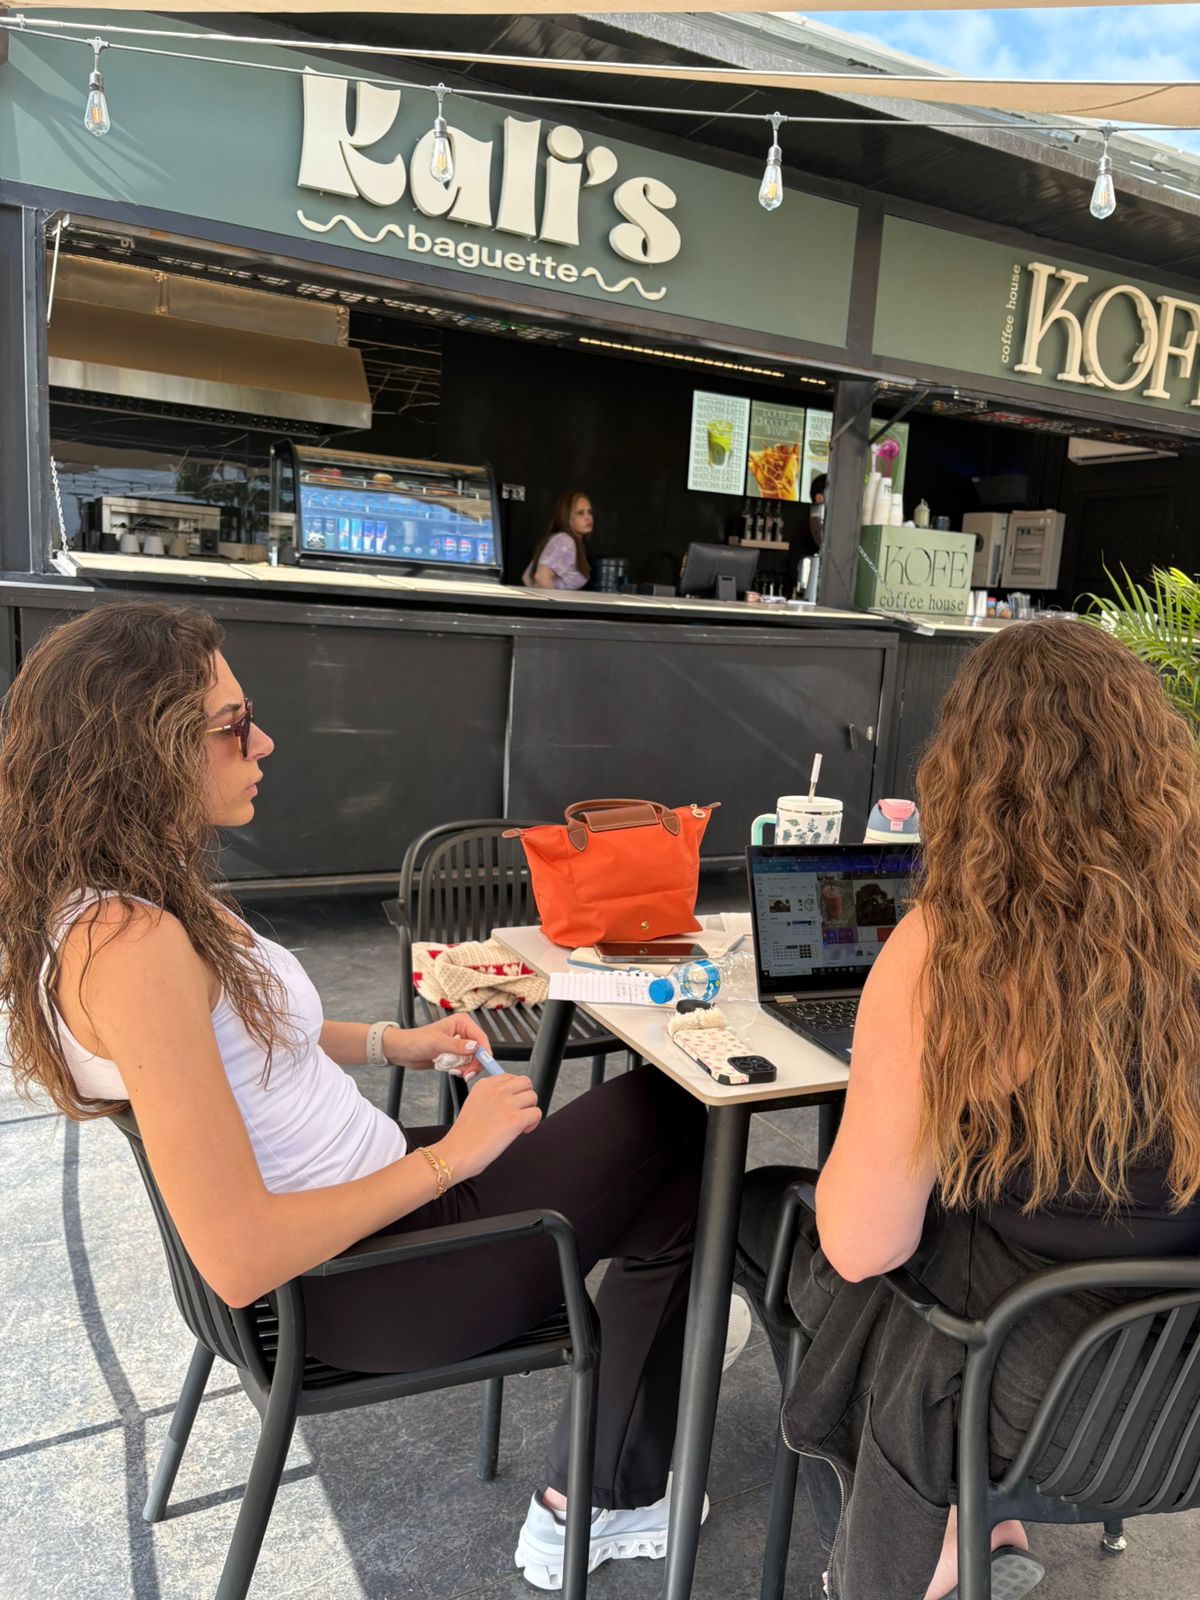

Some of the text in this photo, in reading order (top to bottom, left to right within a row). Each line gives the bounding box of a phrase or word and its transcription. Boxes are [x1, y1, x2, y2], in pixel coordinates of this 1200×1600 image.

[297, 65, 682, 264] Kali's
[407, 224, 580, 283] baguette
[1001, 264, 1021, 364] coffee house
[1014, 262, 1200, 407] KOF
[879, 592, 965, 612] coffee house
